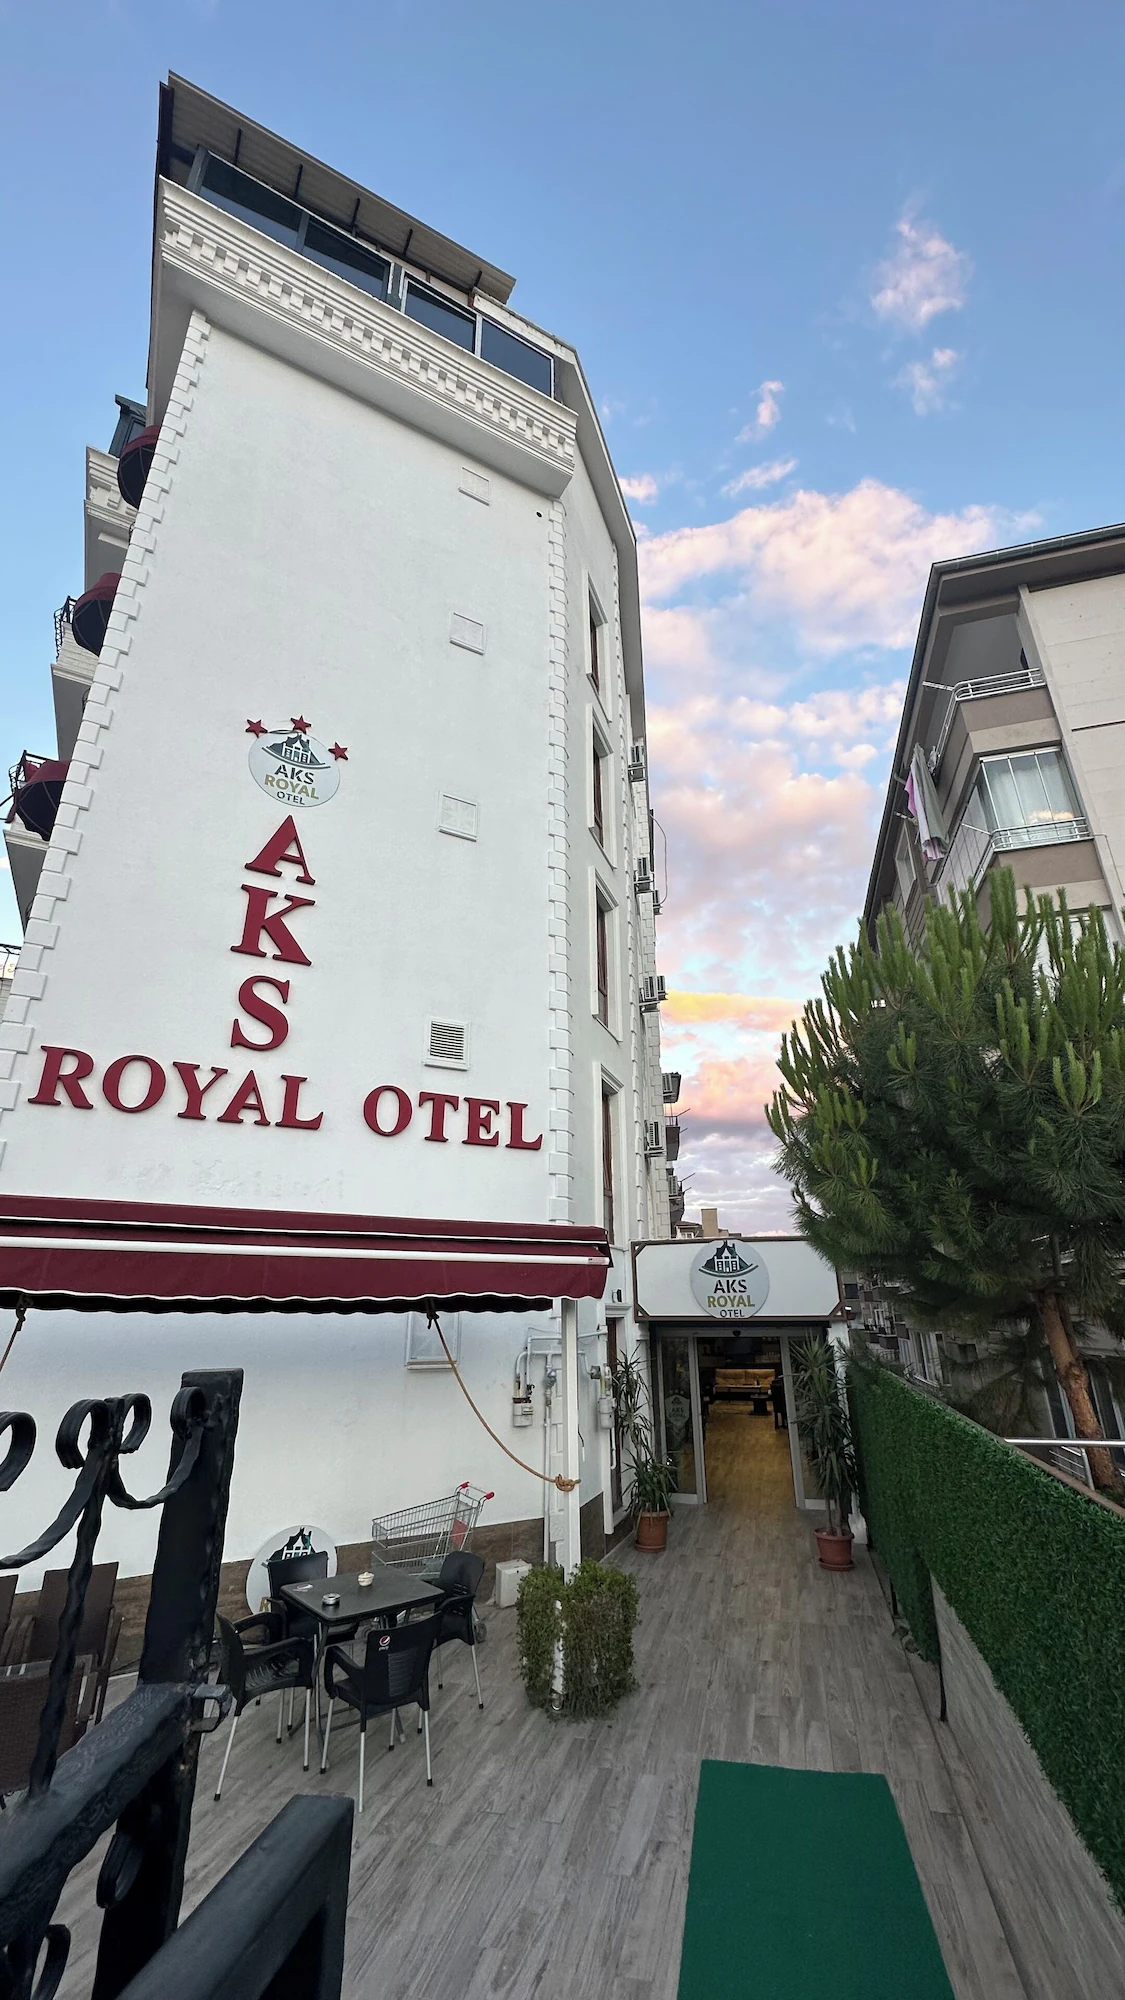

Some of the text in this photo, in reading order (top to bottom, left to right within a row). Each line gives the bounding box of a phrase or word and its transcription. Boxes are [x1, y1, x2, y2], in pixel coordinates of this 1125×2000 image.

[274, 764, 314, 785] AKS
[264, 774, 319, 800] ROYAL
[276, 791, 306, 805] OTEL
[230, 814, 315, 1052] AKS
[28, 1045, 544, 1150] ROYAL OTEL
[713, 1279, 747, 1294] AKS
[707, 1295, 756, 1308] ROYAL
[719, 1309, 745, 1318] OTEL
